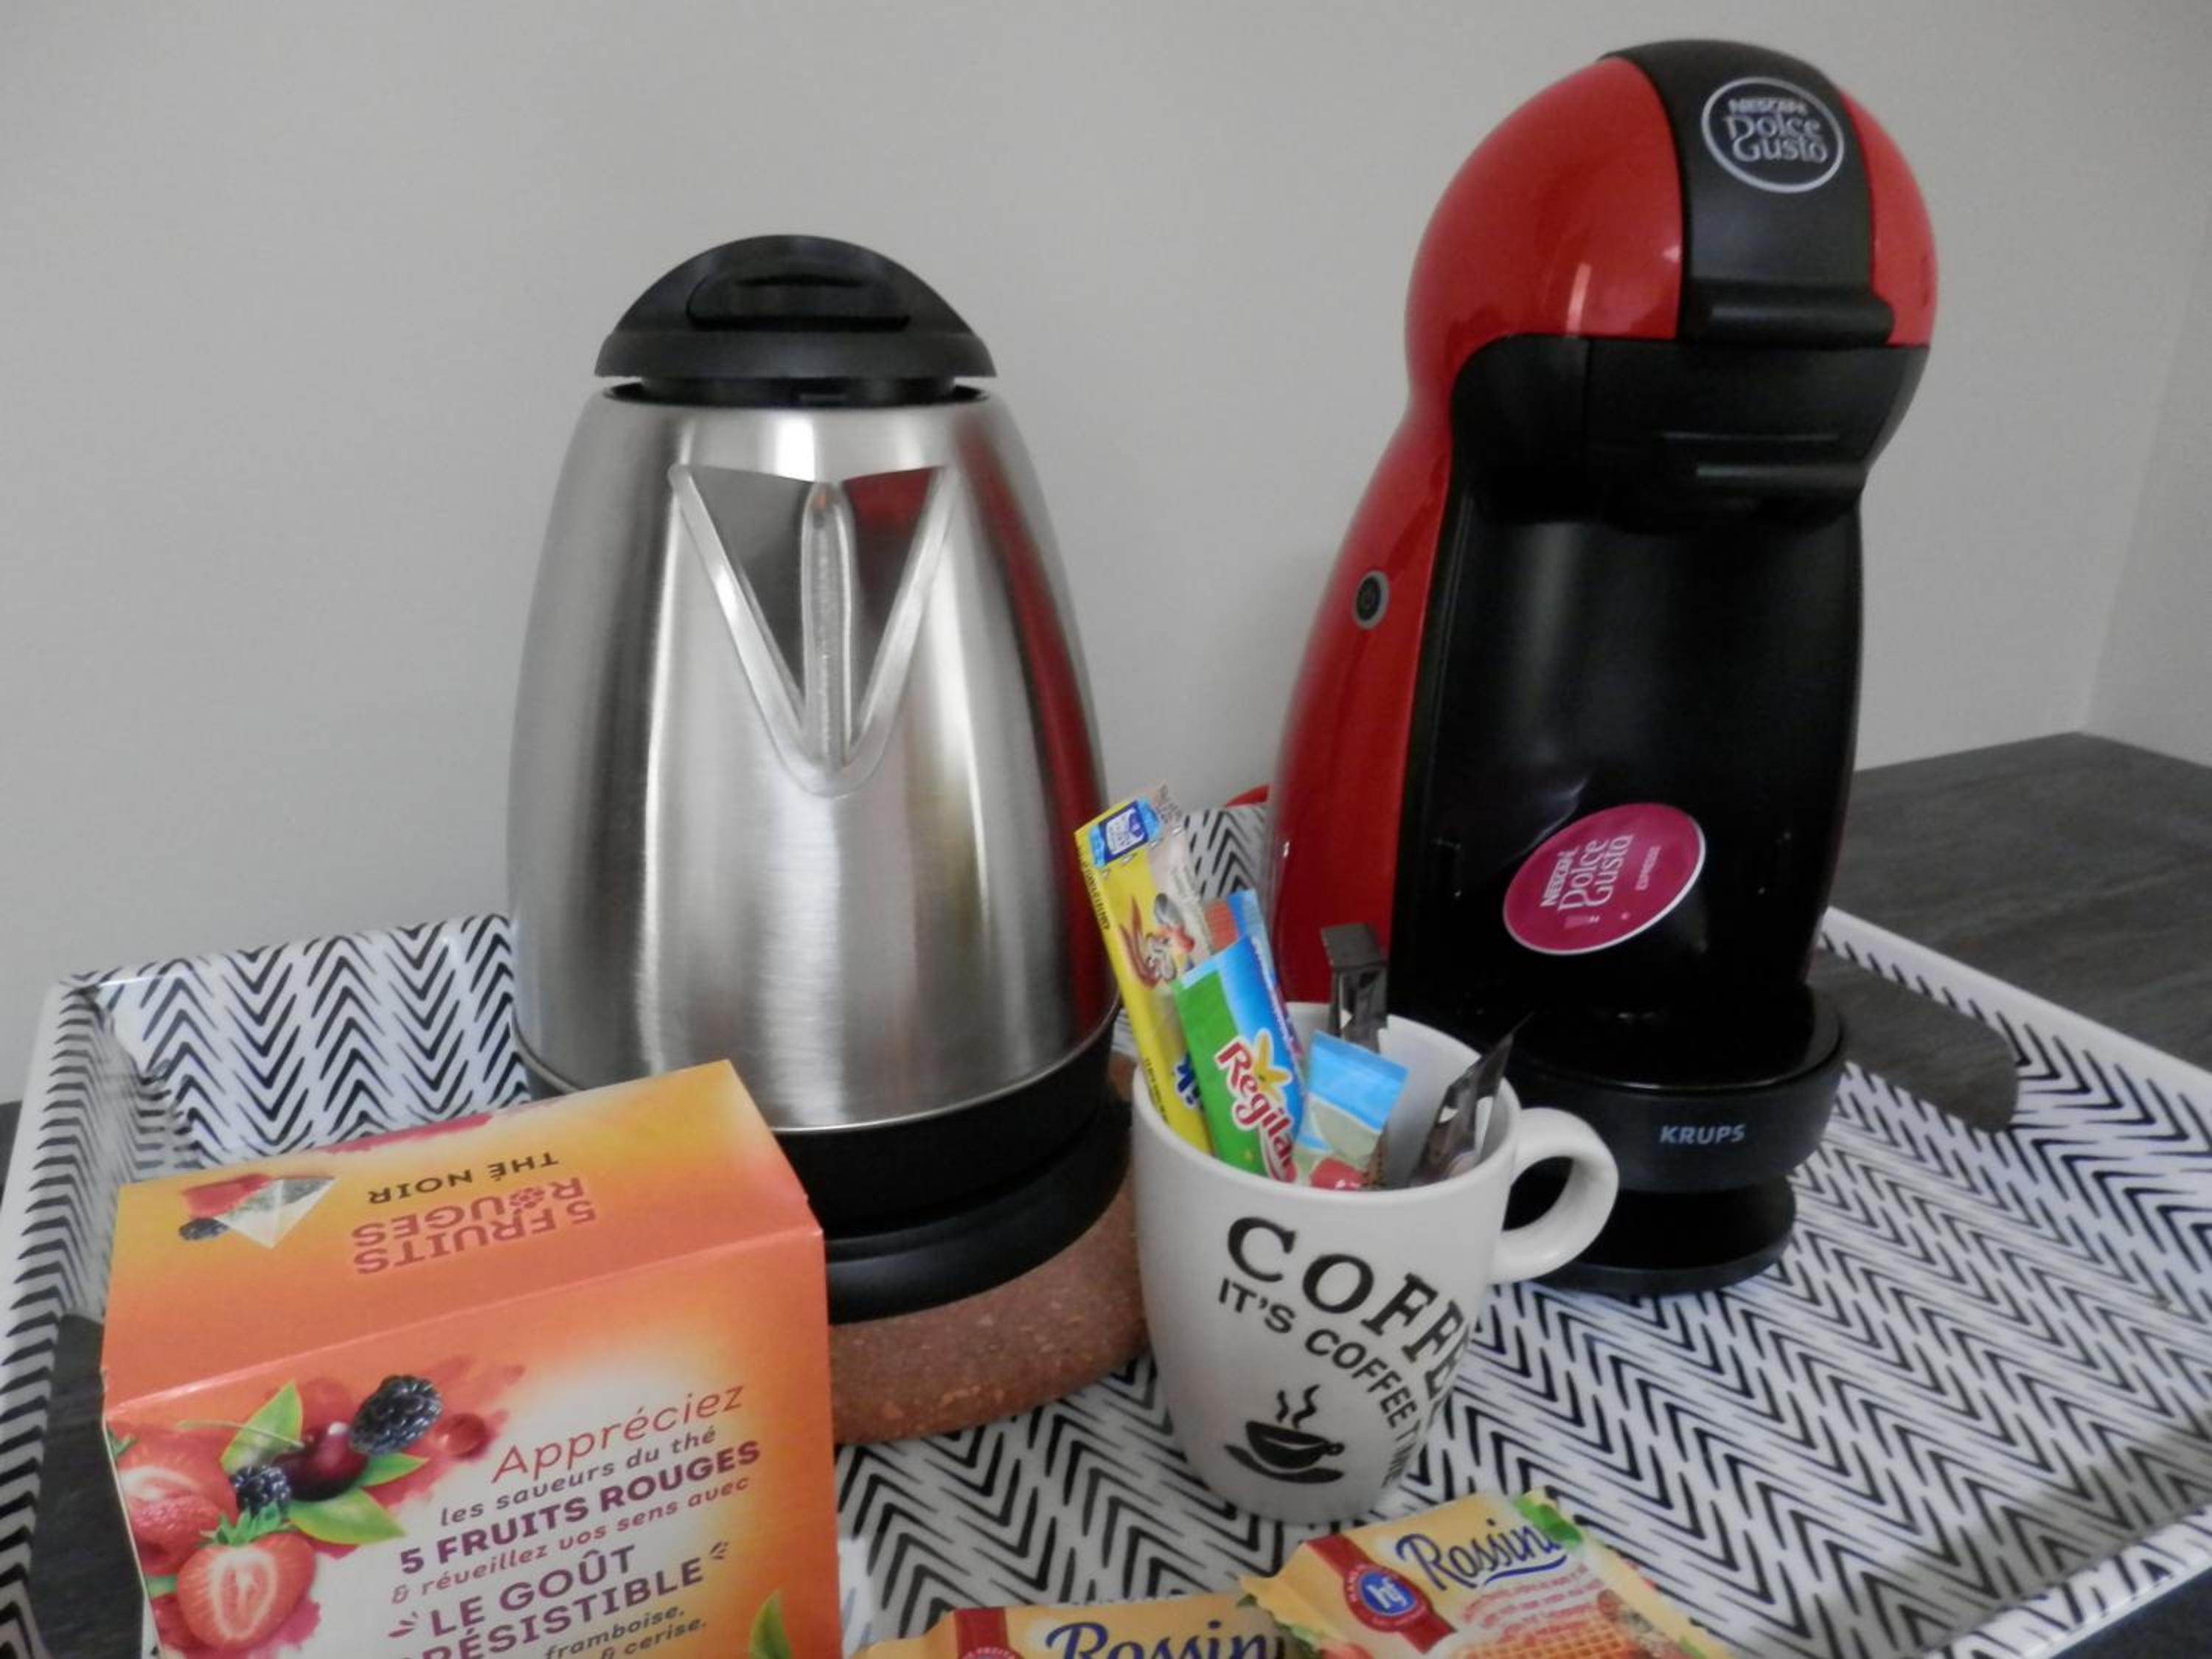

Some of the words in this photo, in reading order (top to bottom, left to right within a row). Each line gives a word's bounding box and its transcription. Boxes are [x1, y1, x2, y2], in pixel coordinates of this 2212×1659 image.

[1723, 111, 1821, 140] Dolce
[1733, 134, 1828, 164] Gusto
[1557, 838, 1610, 911] Dolce
[1585, 833, 1636, 907] Gusto
[487, 1152, 559, 1182] THÉ
[1660, 1124, 1747, 1144] KRUPS
[368, 1169, 473, 1204] NOIR
[566, 1200, 597, 1225] 5
[353, 1208, 557, 1275] FRUITS
[1219, 1278, 1296, 1334] IT'S
[1304, 1328, 1417, 1428] COFFEE
[491, 1385, 745, 1484] Appréciez
[400, 1548, 425, 1575] 5
[437, 1497, 591, 1565] FRUITS
[599, 1440, 762, 1513] ROUGES
[440, 1503, 484, 1527] les
[496, 1462, 614, 1510] saveurs
[626, 1447, 660, 1470] du
[671, 1425, 717, 1454] thé
[421, 1543, 549, 1597] réveillez
[559, 1526, 606, 1551] vos
[616, 1503, 678, 1532] sens
[687, 1477, 750, 1509] avec
[430, 1596, 486, 1638] LE
[499, 1544, 636, 1612] GOÛT
